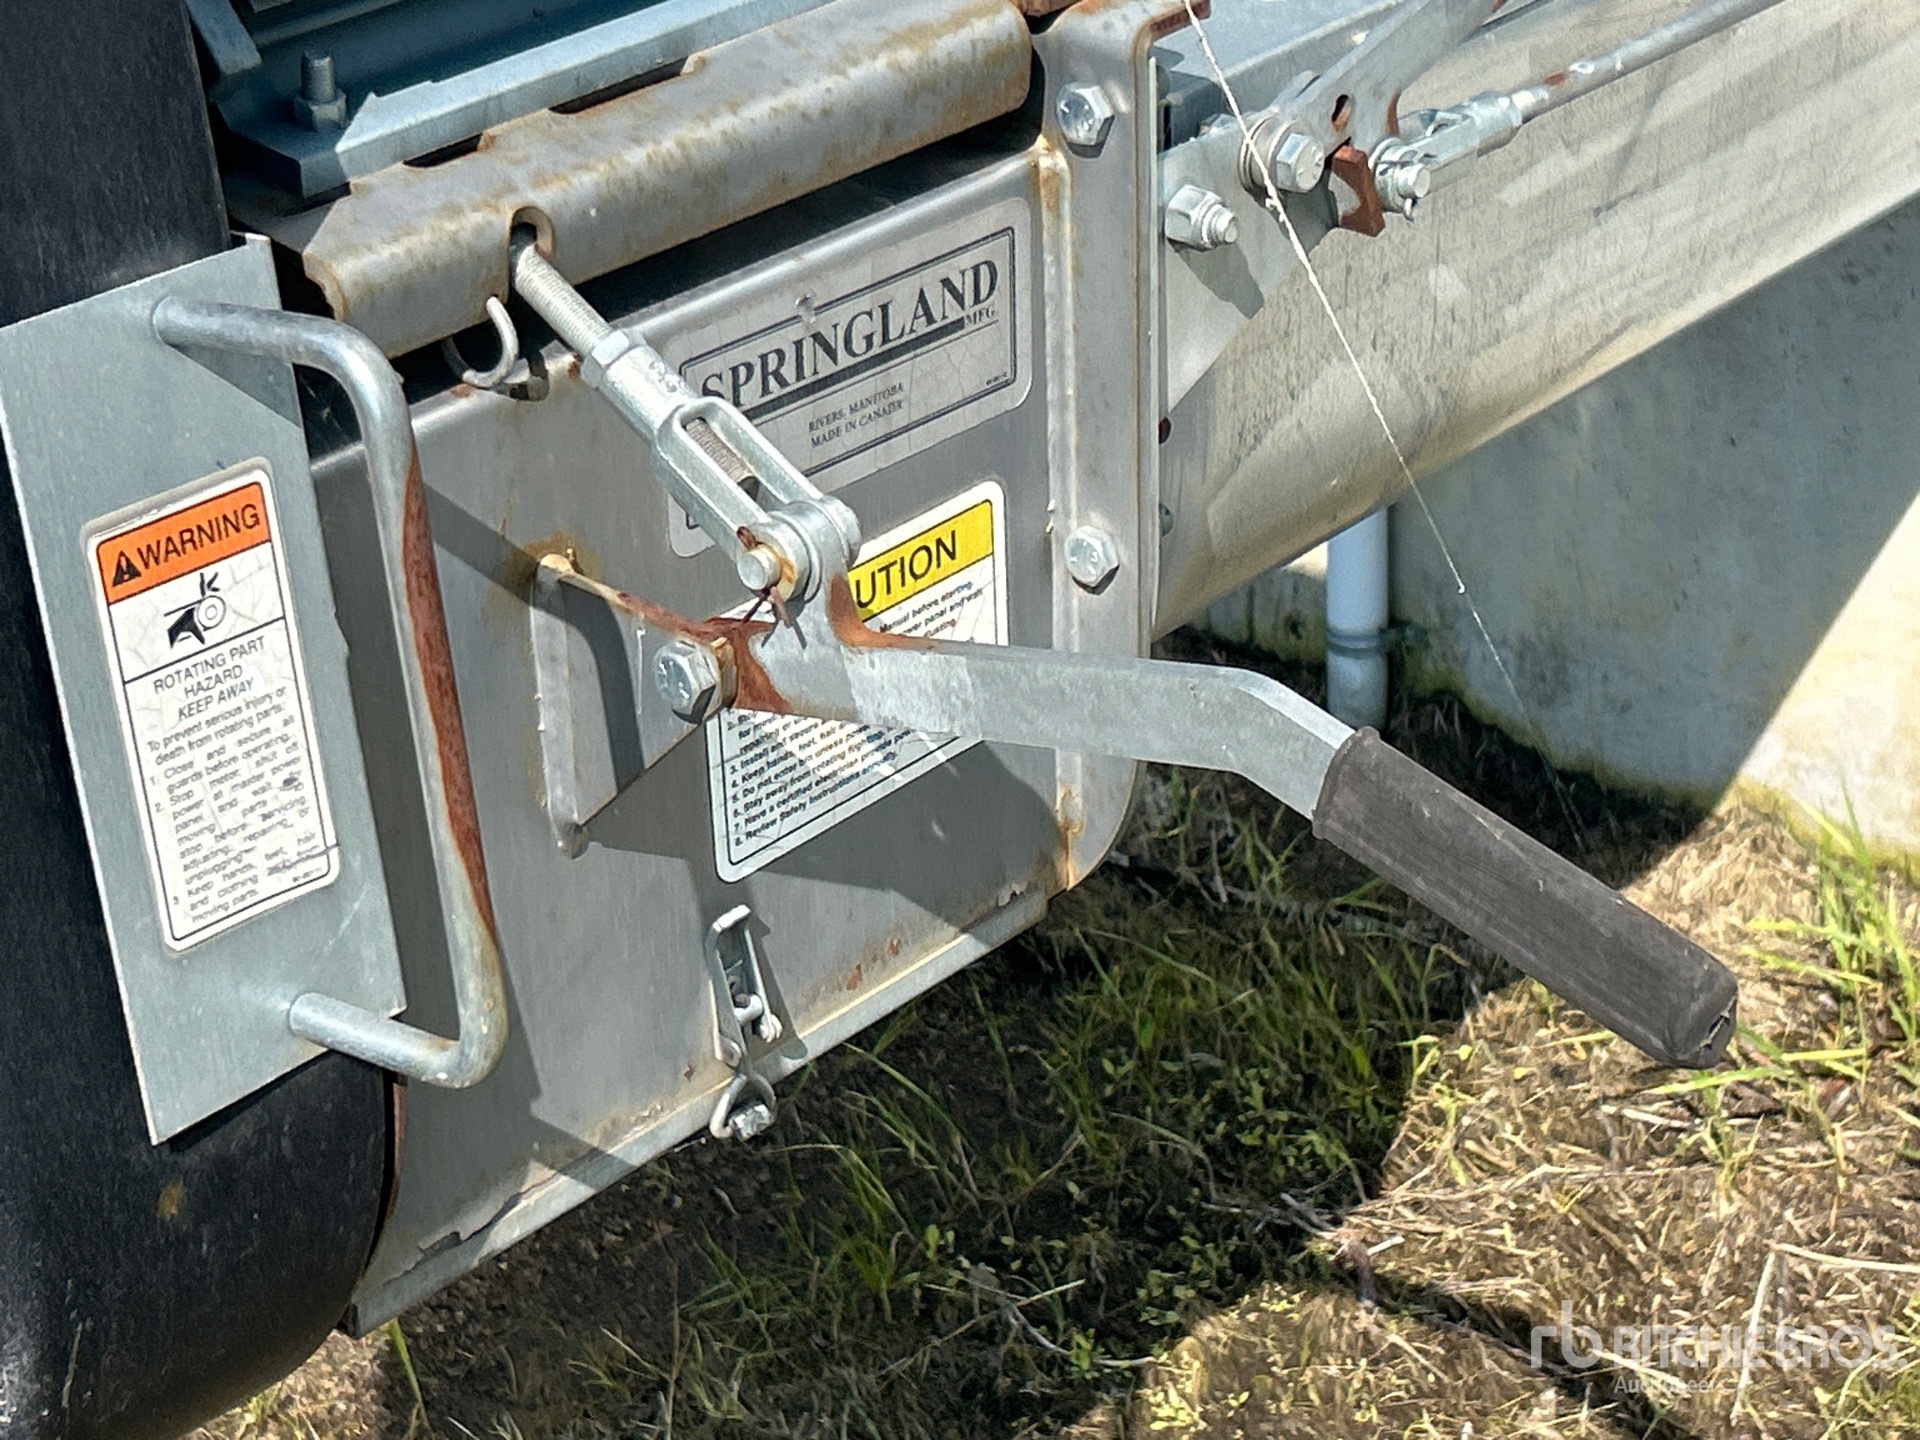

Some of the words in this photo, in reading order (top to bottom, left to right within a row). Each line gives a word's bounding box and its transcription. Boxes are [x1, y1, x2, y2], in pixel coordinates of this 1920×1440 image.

[702, 260, 998, 407] SPRINGLAND
[811, 426, 842, 448] MADE
[845, 420, 857, 432] IN
[136, 503, 260, 570] WARNING
[855, 530, 957, 608] UTION
[879, 613, 909, 634] Manual
[912, 599, 939, 618] before
[925, 607, 946, 626] panel
[153, 653, 226, 694] ROTATING
[230, 635, 264, 661] PART
[184, 665, 242, 698] HAZARD
[147, 740, 160, 752] To
[163, 721, 202, 749] prevent
[205, 706, 243, 728] serious
[244, 693, 273, 710] injury
[276, 687, 285, 697] or
[179, 695, 213, 721] KEEP
[218, 678, 253, 704] AWAY
[155, 746, 185, 765] death
[188, 735, 212, 750] from
[214, 716, 254, 739] rotating
[164, 761, 194, 779] Close
[207, 745, 225, 760] and
[237, 727, 271, 747] secure
[283, 715, 295, 727] all
[742, 766, 765, 783] Keep
[820, 727, 835, 739] hair
[770, 737, 786, 753] and
[789, 722, 818, 742] secure
[167, 771, 203, 795] guards
[205, 756, 238, 775] before
[173, 799, 204, 821] power
[213, 790, 223, 801] at
[231, 772, 264, 792] master
[271, 757, 301, 776] power
[743, 786, 755, 798] Do
[757, 776, 773, 791] not
[774, 763, 797, 780] enter
[798, 755, 812, 767] bin
[815, 738, 843, 757] unless
[744, 797, 763, 813] Stay
[765, 782, 789, 800] away
[790, 770, 811, 786] from
[812, 751, 845, 776] rotating
[170, 790, 194, 806] Stop
[745, 809, 766, 827] Have
[776, 781, 812, 808] certified
[815, 759, 858, 787] electrician
[175, 814, 203, 834] panel
[218, 798, 238, 813] and
[177, 823, 216, 846] moving
[241, 800, 267, 818] parts
[745, 818, 777, 840] Review
[780, 802, 807, 821] Safety
[180, 843, 203, 859] stop
[214, 823, 248, 843] before
[187, 881, 214, 897] Keep
[190, 895, 209, 911] and
[218, 875, 258, 897] clothing
[192, 902, 230, 923] moving
